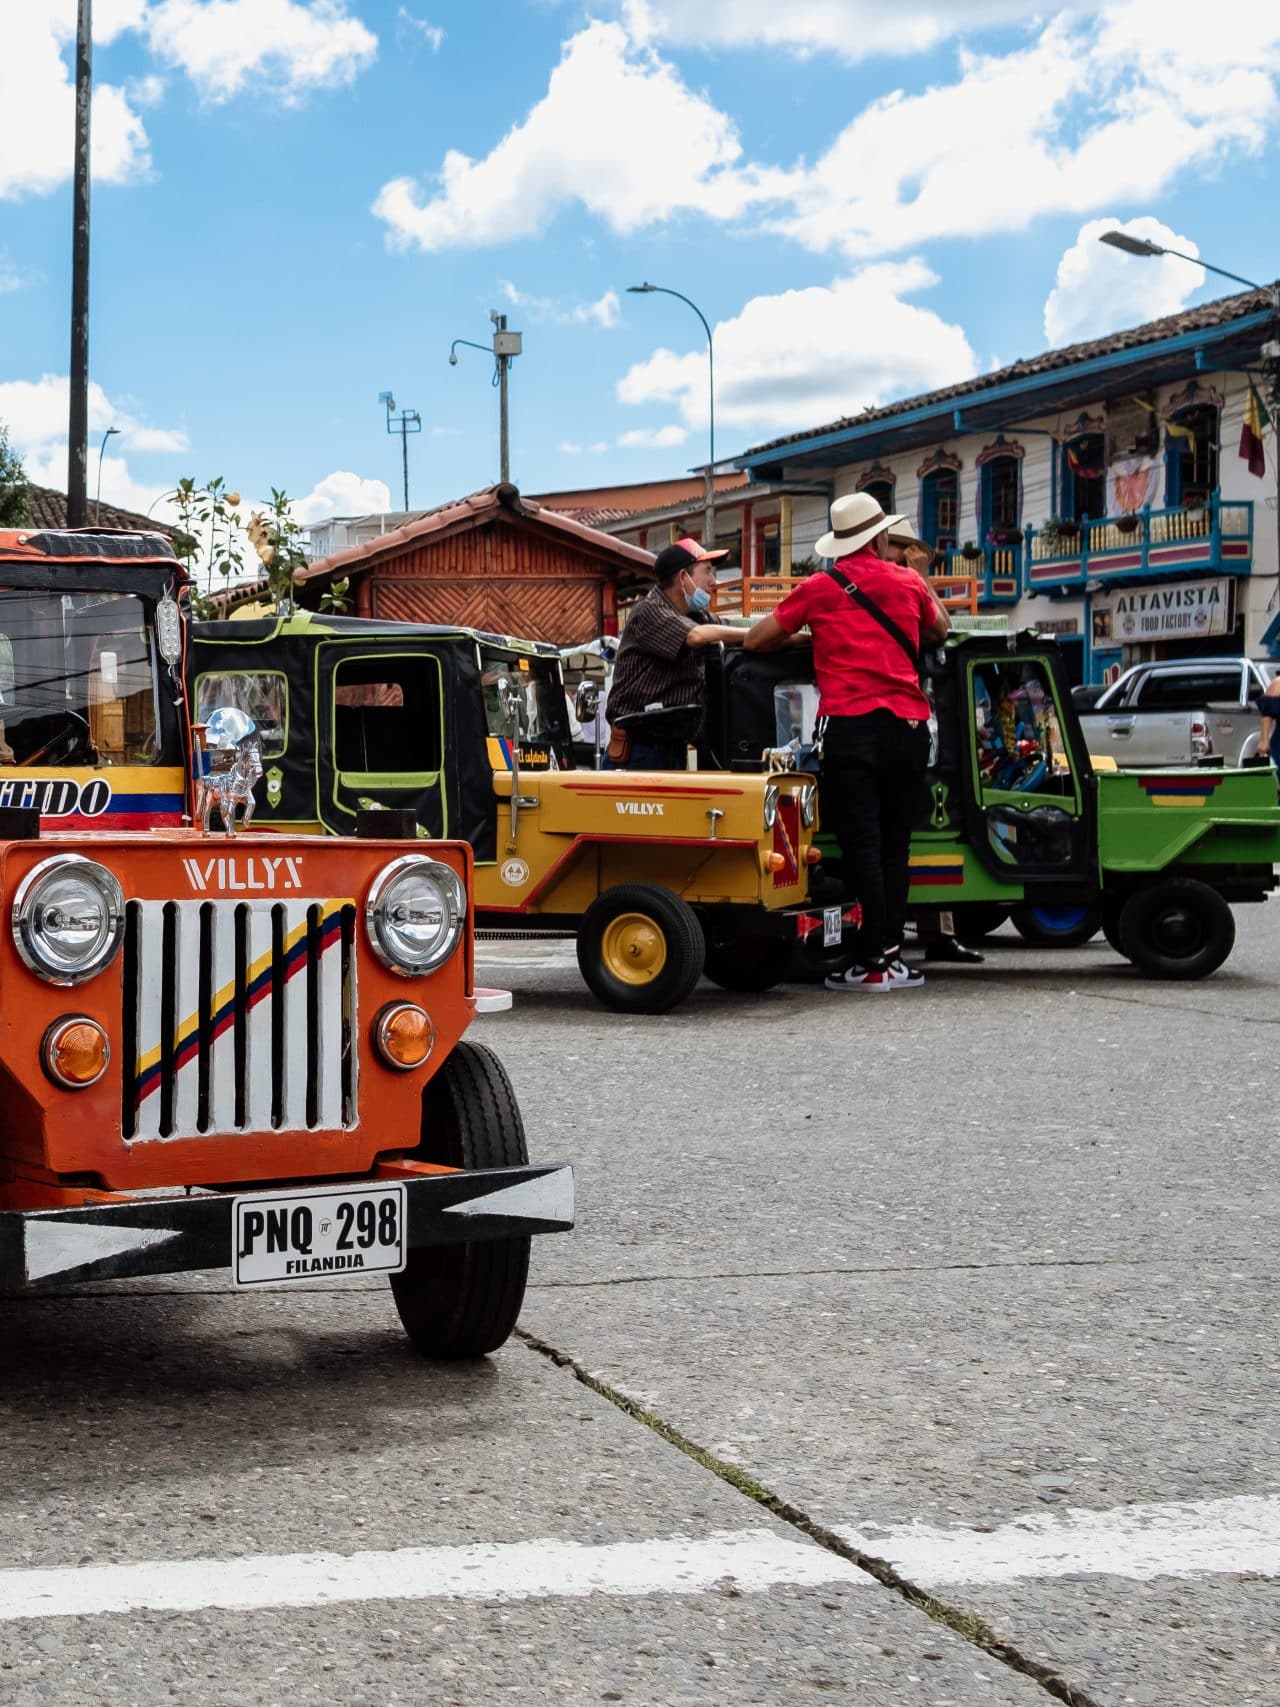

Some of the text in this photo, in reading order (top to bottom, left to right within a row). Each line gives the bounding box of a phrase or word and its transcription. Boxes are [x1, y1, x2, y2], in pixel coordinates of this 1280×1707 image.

[1117, 586, 1220, 614] ALTAVISTA
[1141, 616, 1159, 632] FOOD
[1161, 612, 1191, 630] FACTORY
[182, 857, 303, 890] WILLYS
[243, 1198, 397, 1256] PNQ 298
[286, 1253, 364, 1274] FILANDIA
